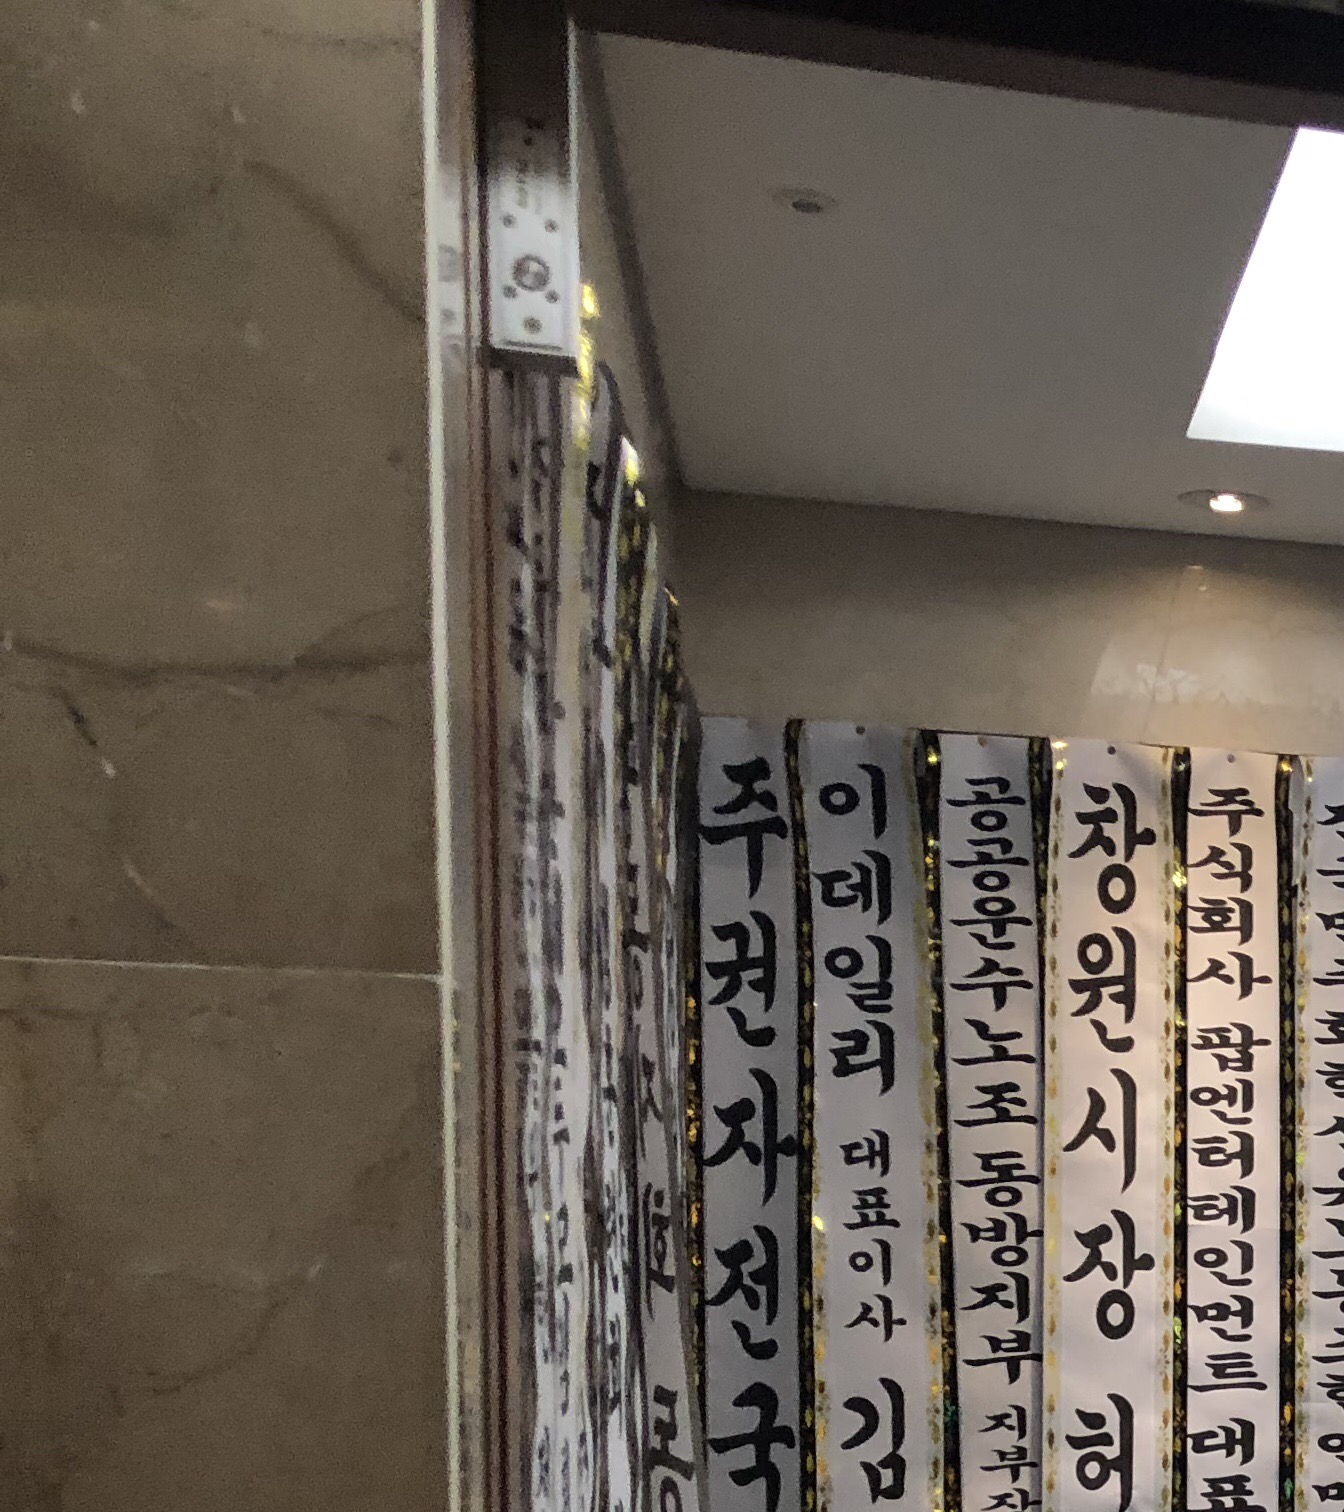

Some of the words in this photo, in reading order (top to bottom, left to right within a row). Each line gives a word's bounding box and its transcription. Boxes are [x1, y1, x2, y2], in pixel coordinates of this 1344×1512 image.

[812, 764, 896, 1097] 이데일리
[1187, 787, 1272, 1000] 주식회사
[1062, 782, 1156, 1341] 창원시장
[1187, 1022, 1271, 1392] 팝엔터테인먼트
[839, 1129, 907, 1343] 대표이사
